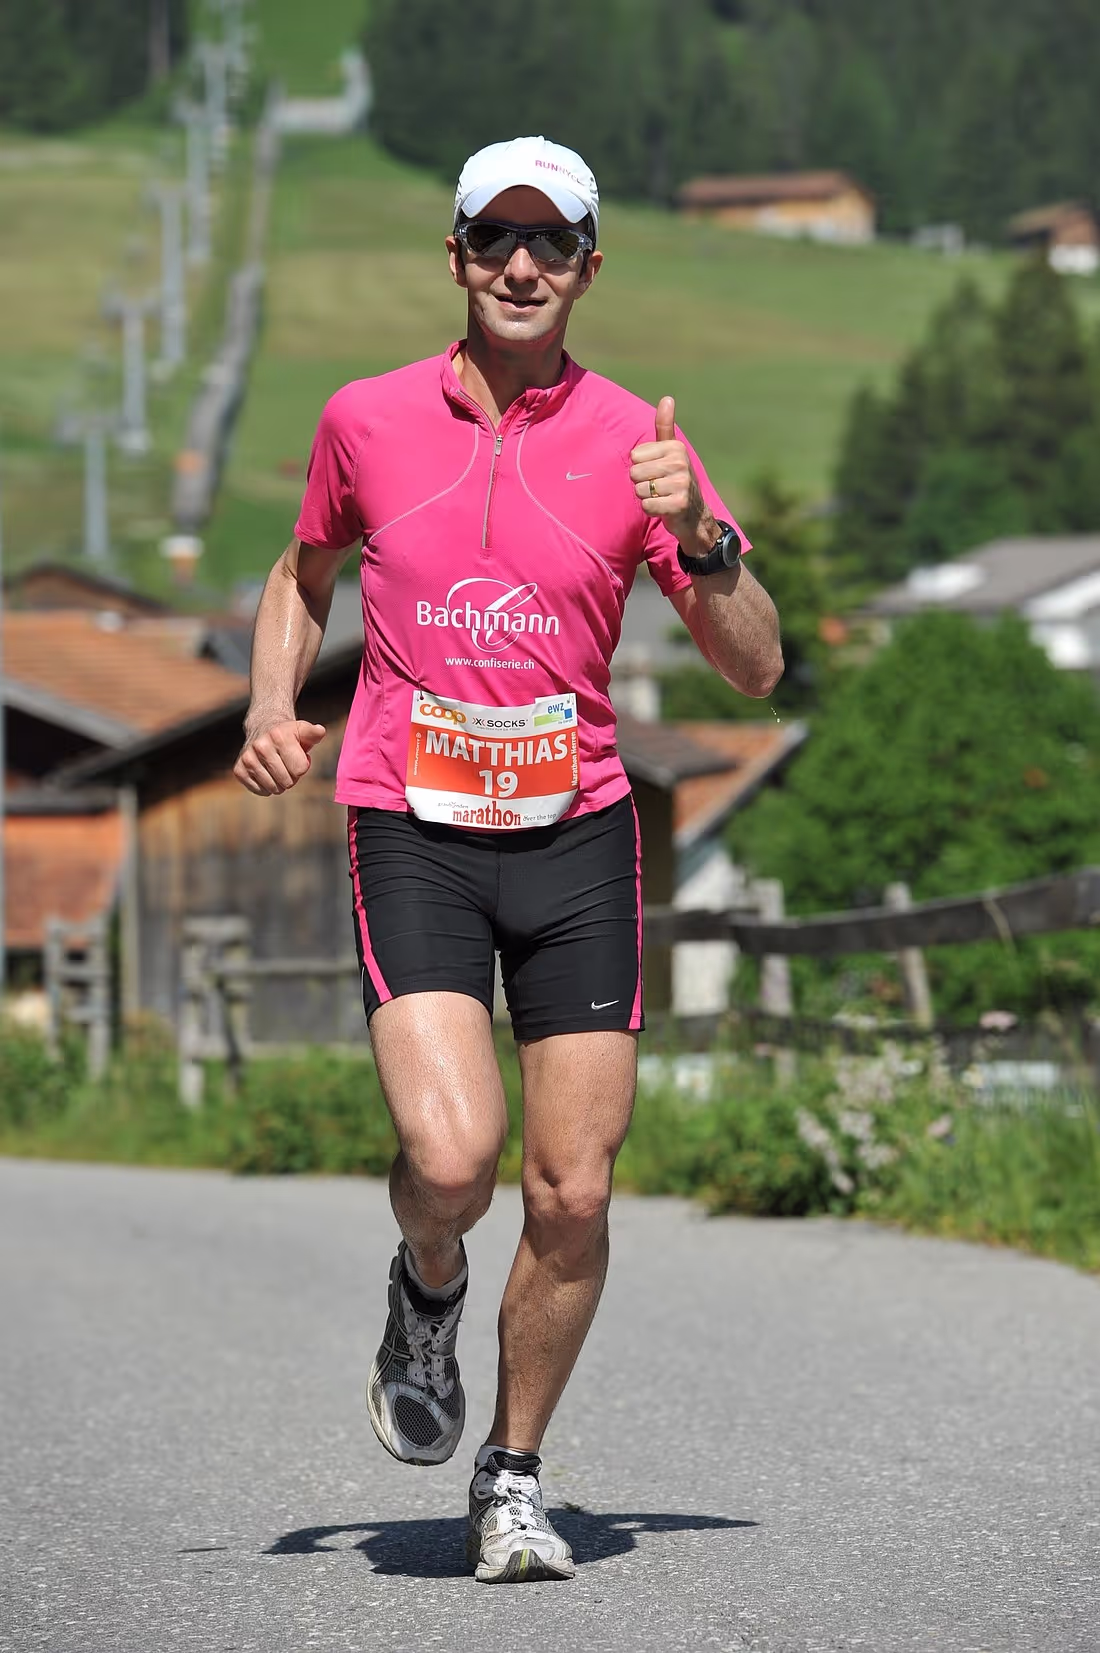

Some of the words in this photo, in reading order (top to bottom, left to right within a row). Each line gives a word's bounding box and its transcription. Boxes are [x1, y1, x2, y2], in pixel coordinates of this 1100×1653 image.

[416, 600, 560, 635] Bachmann
[445, 657, 535, 670] www.confiserie.ch
[419, 703, 467, 725] coop
[547, 702, 564, 714] ewz
[487, 719, 526, 728] SOCKS
[425, 730, 568, 767] MATTHIAS
[479, 769, 518, 798] 19
[452, 800, 521, 826] marathon
